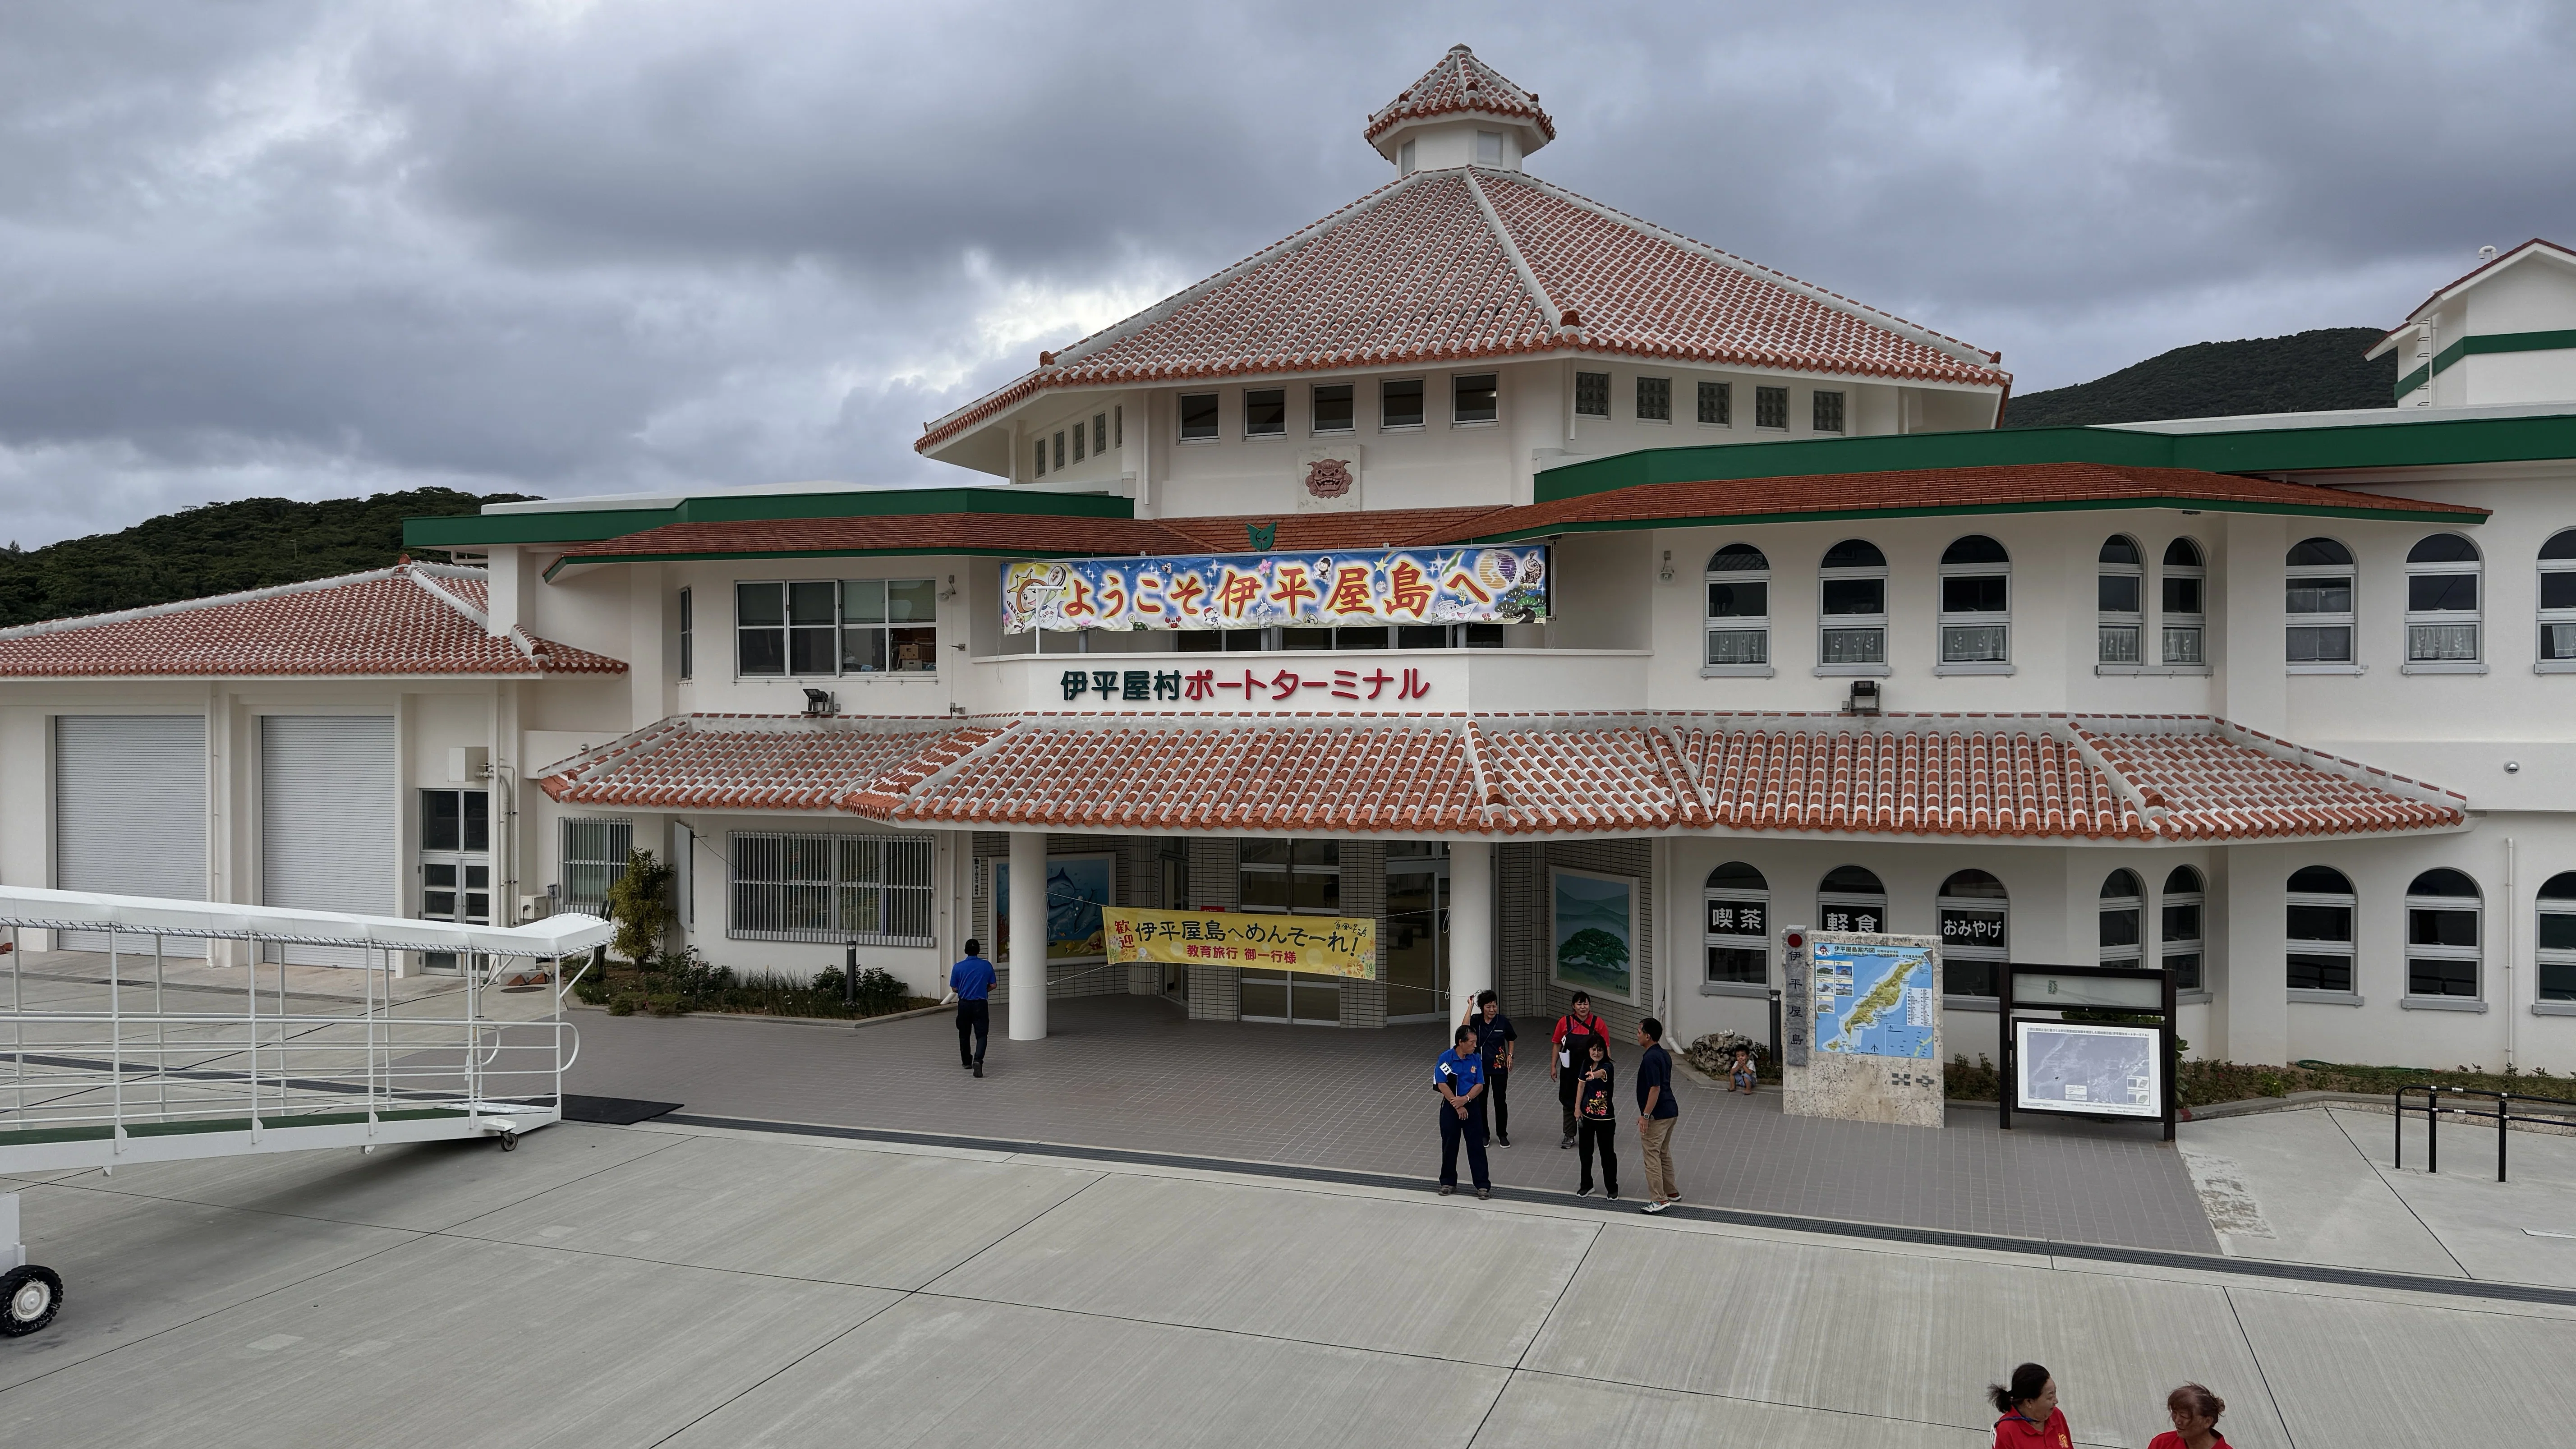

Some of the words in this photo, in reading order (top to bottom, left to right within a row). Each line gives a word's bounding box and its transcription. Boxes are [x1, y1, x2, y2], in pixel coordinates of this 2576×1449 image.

[1064, 560, 1490, 619] ようこそ伊平屋島へ
[1061, 669, 1430, 701] 伊平屋村ポートターミナル
[1712, 908, 1762, 929] 喫茶
[1826, 913, 1878, 933] 軽食
[1944, 918, 2002, 938] おみやげ
[1114, 920, 1135, 948] 歓迎
[1135, 920, 1358, 957] 伊平屋島へめんそーれ!
[1187, 944, 1238, 960] 教育旅行
[1244, 948, 1297, 964] 御一行様
[1788, 951, 1803, 1045] 伊平屋島
